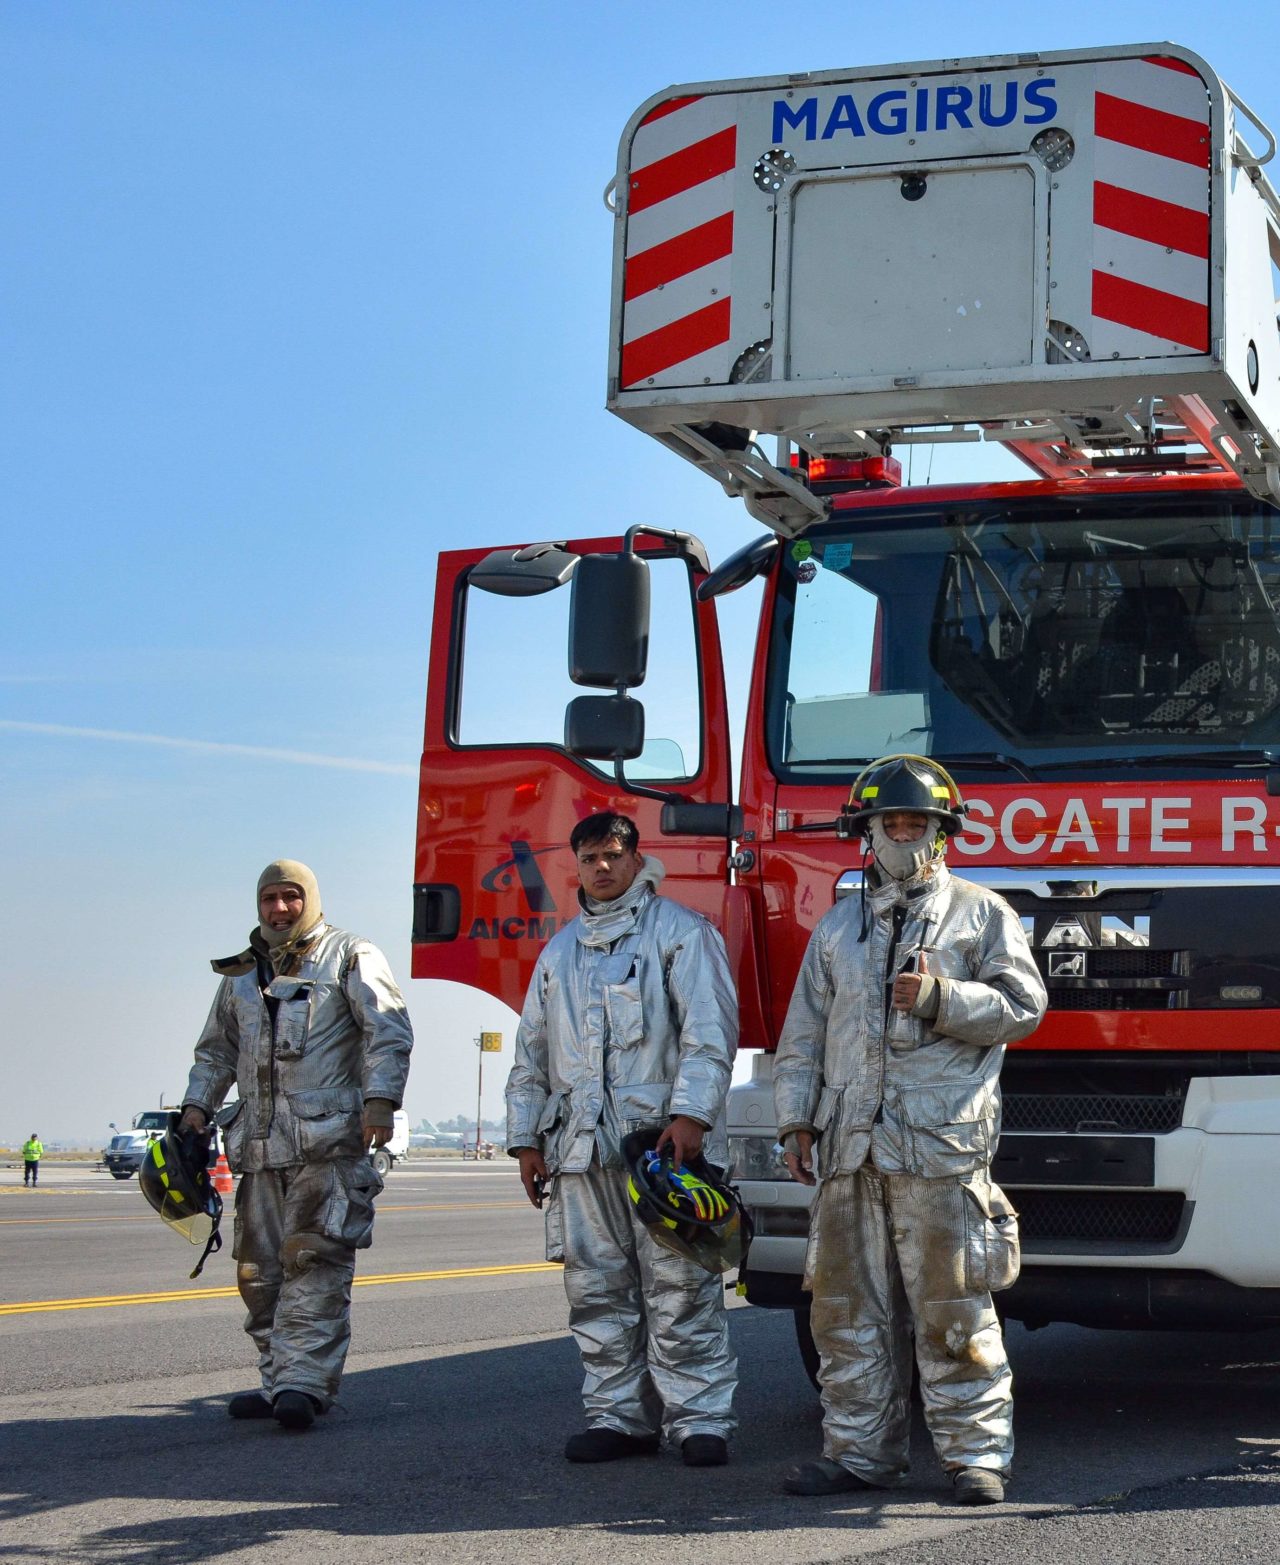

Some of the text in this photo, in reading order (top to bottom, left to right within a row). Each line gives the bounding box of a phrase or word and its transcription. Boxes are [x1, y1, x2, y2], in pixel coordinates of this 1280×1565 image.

[771, 78, 1058, 143] MAGIRUS
[860, 797, 1192, 854] SCATE
[467, 916, 557, 940] AICM
